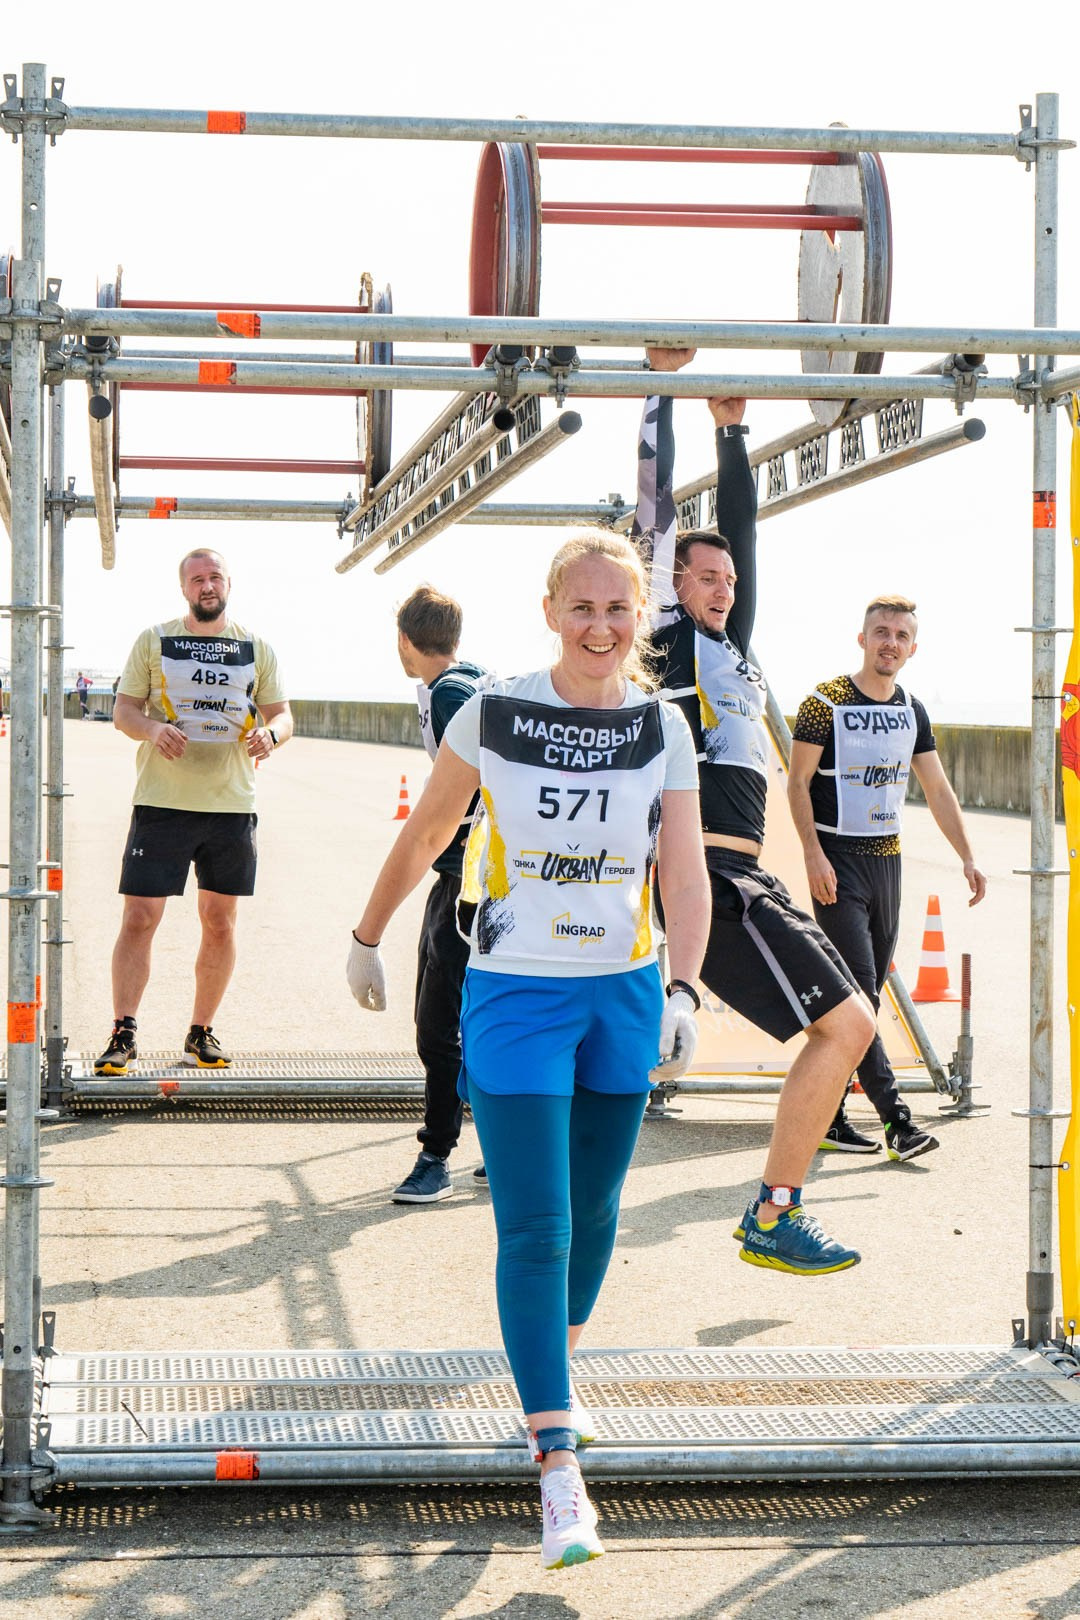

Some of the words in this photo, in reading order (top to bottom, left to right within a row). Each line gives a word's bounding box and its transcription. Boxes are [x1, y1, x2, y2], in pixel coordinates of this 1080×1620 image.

[174, 640, 241, 655] МАССОВЫЙ
[190, 650, 226, 663] СТАРТ
[191, 668, 229, 686] 482
[193, 698, 227, 713] URBAN
[204, 724, 229, 732] INGRAD
[512, 715, 644, 748] МАССОВЫЙ
[843, 711, 911, 735] СУДЬЯ
[543, 743, 617, 768] СТАРТ
[863, 760, 901, 788] URBAN
[537, 785, 610, 823] 571
[871, 812, 897, 821] INGRAD
[512, 858, 536, 870] ОНКА
[540, 848, 608, 886] URBAN
[604, 866, 636, 876] ГЕРОЕВ
[556, 923, 606, 937] INGRAD
[747, 1229, 777, 1251] HOKA
